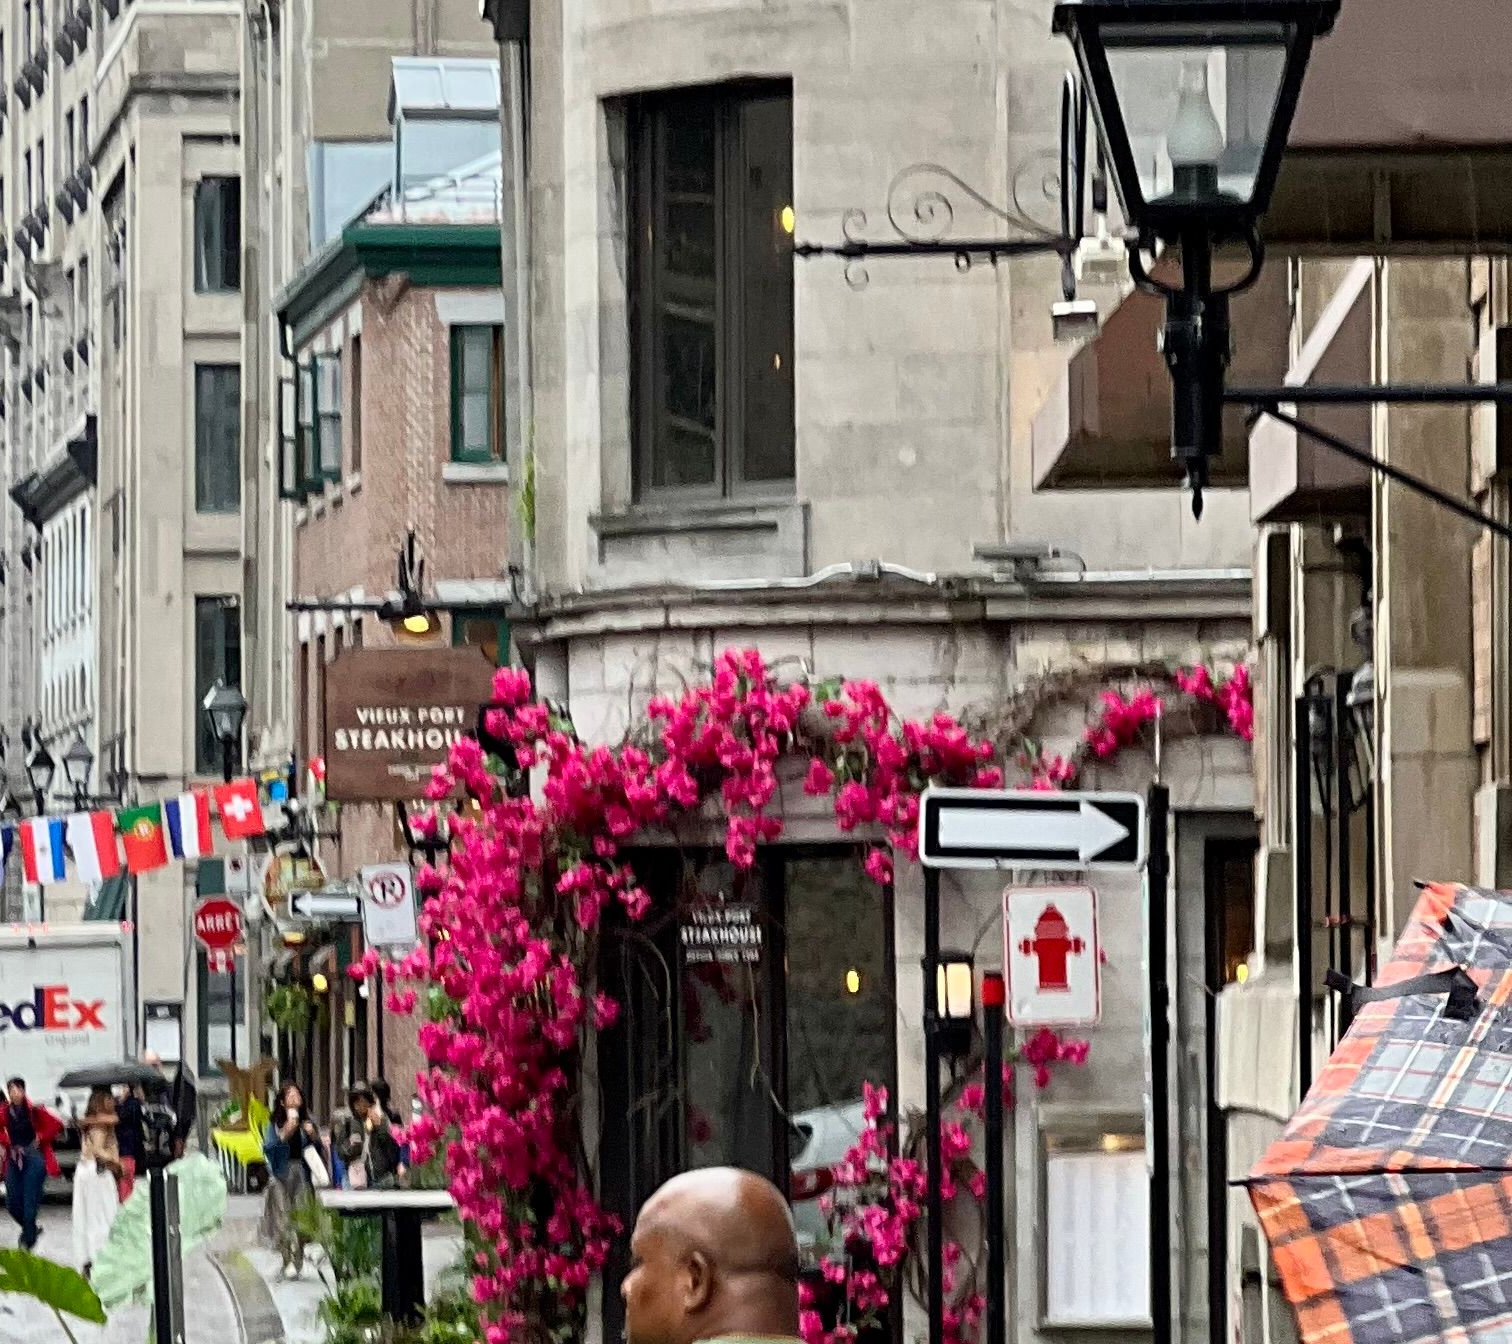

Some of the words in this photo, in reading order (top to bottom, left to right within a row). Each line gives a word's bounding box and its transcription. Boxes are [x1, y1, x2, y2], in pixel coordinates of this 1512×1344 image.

[356, 706, 411, 725] VIEUX
[417, 706, 465, 725] PORT
[335, 727, 462, 750] STEAKHOU
